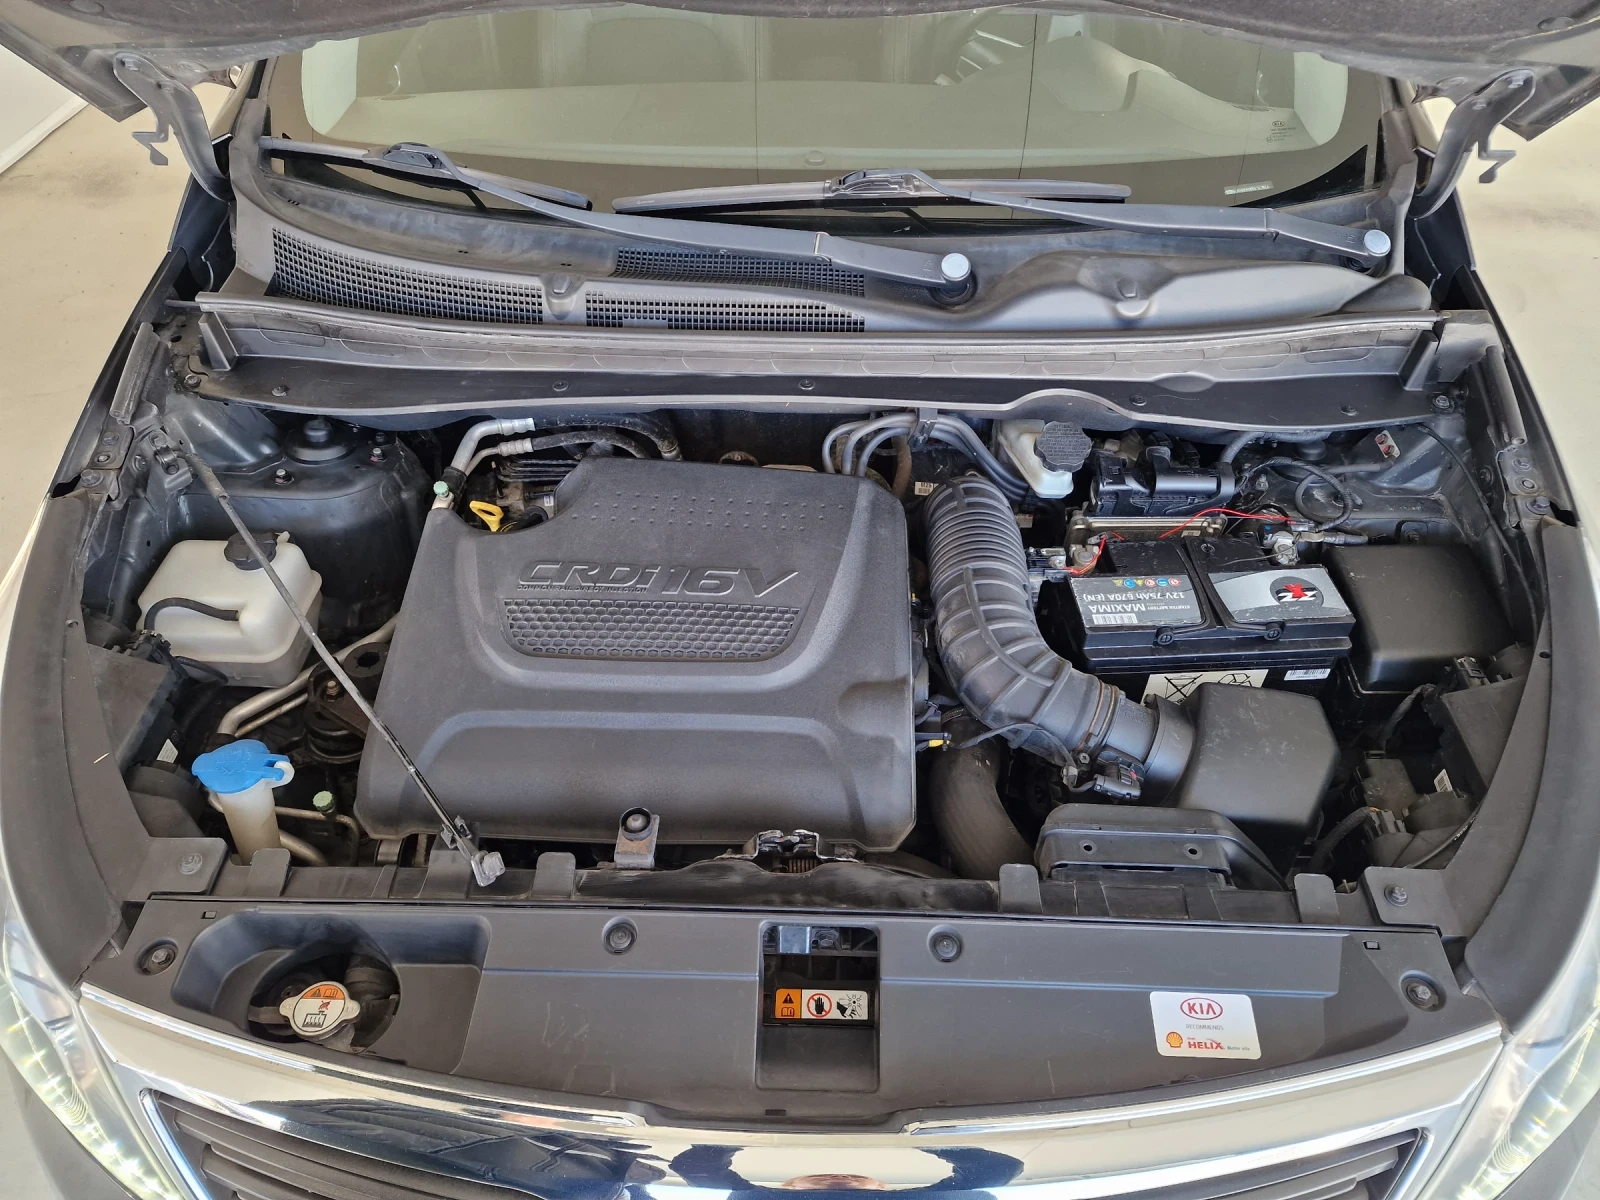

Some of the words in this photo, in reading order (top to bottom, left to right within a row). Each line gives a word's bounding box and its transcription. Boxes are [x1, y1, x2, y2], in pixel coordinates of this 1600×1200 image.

[661, 566, 799, 598] 16V
[1083, 593, 1106, 602] (EN)
[1107, 593, 1134, 601] 670A
[1136, 592, 1160, 600] 75Ah
[1088, 603, 1146, 613] MAXIMA
[1187, 1002, 1217, 1016] KIA
[1188, 1040, 1224, 1050] HELIX
